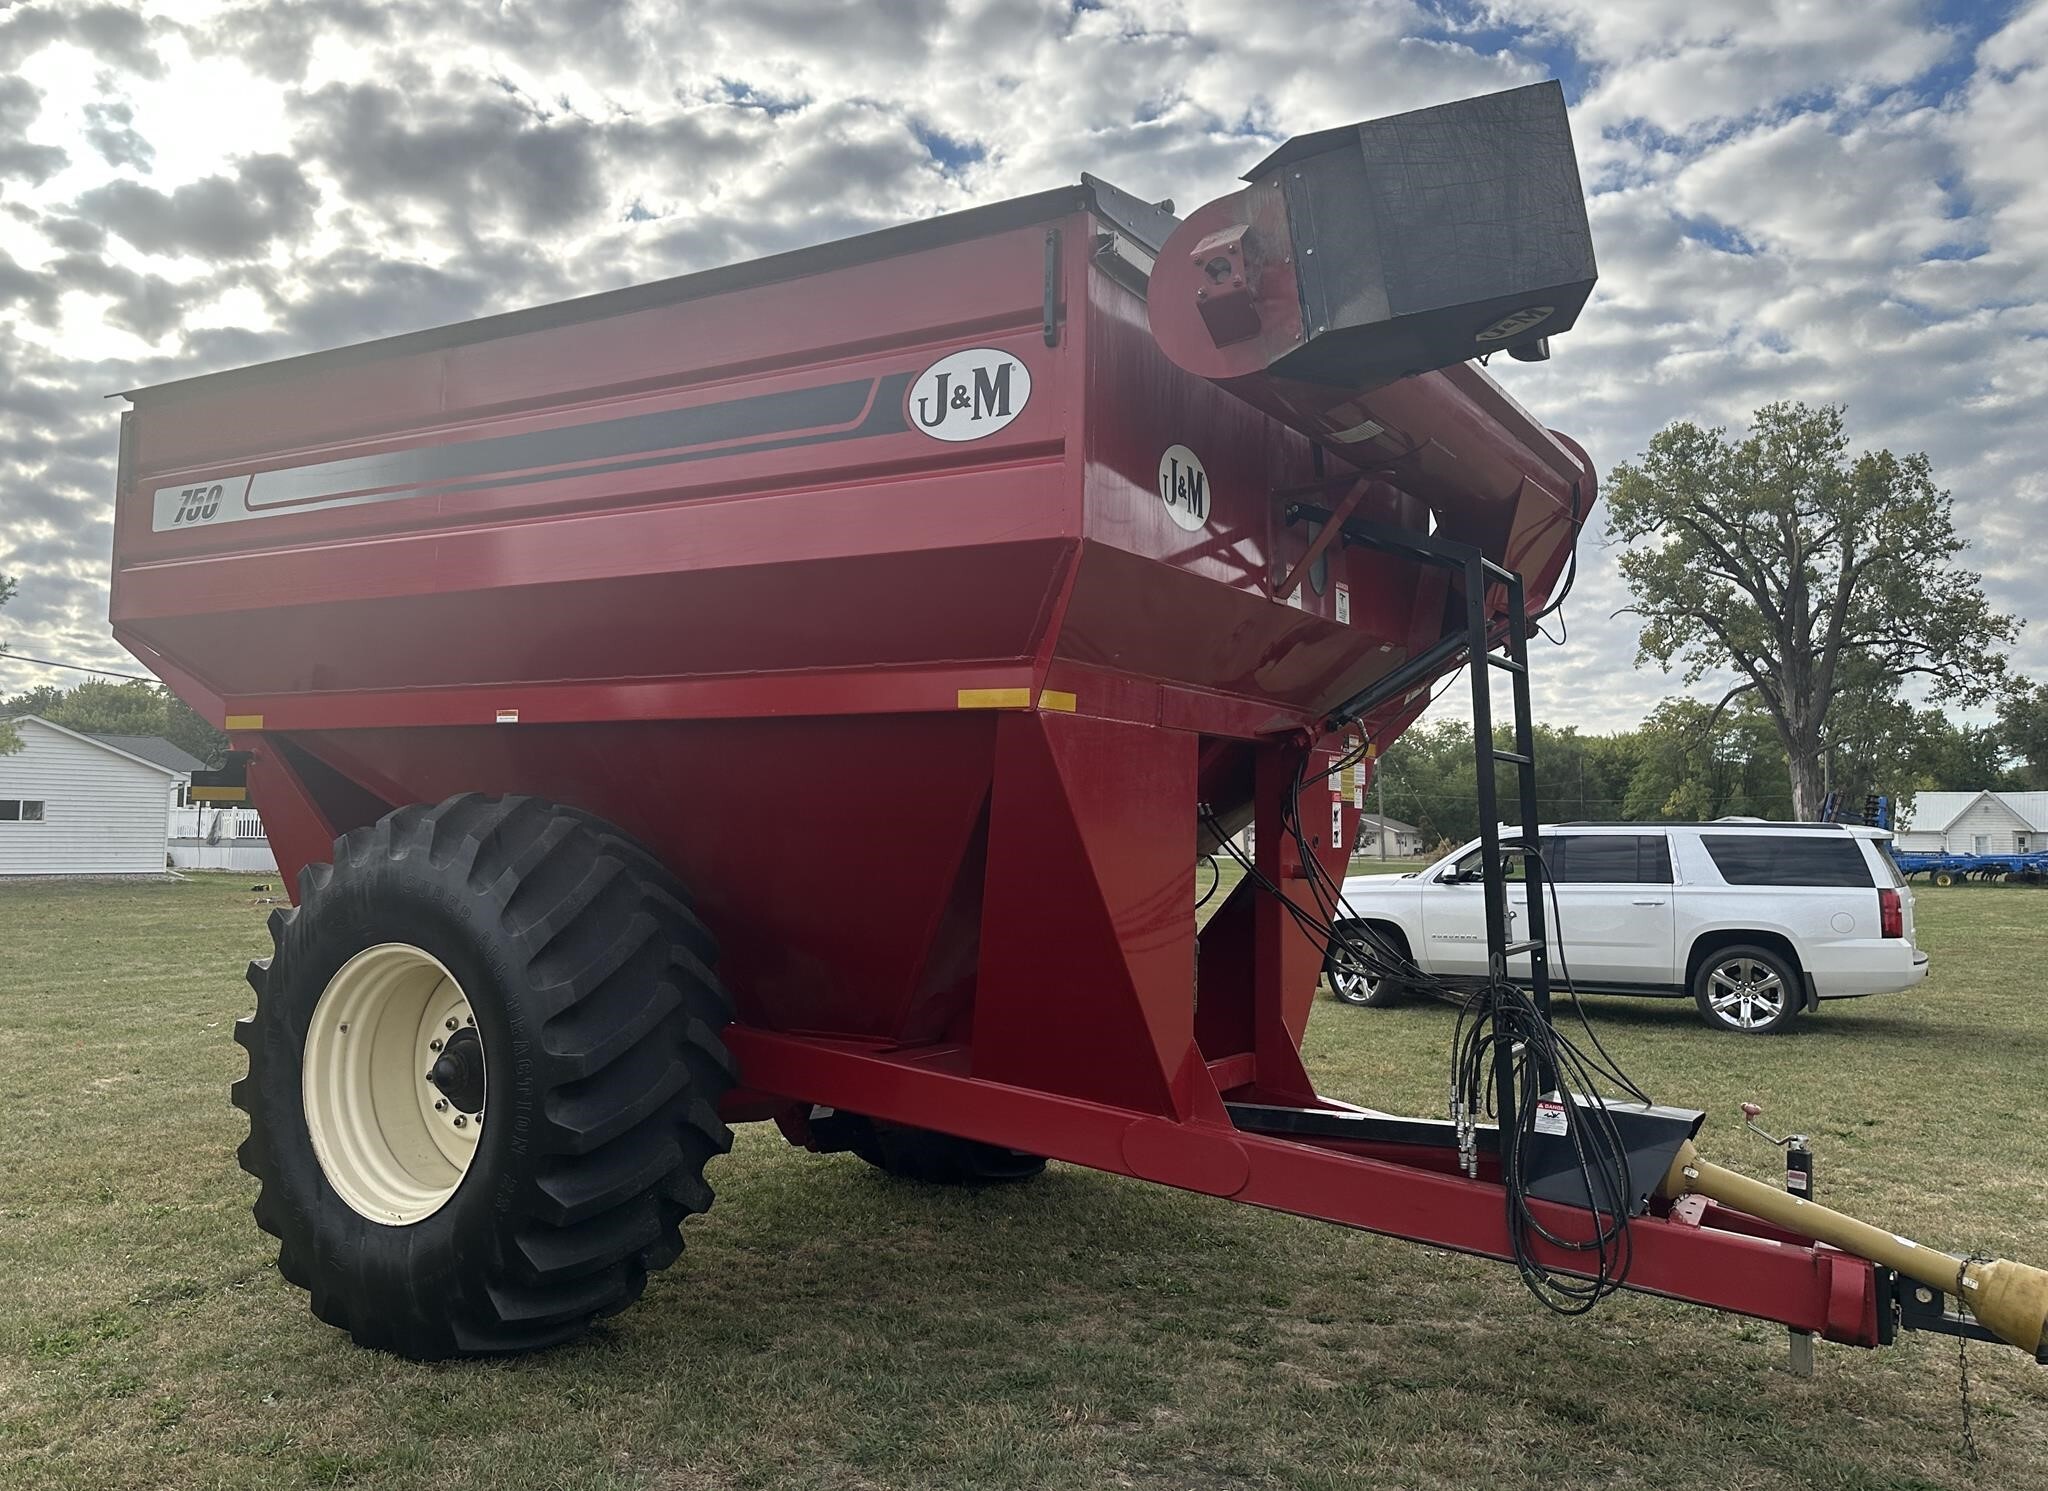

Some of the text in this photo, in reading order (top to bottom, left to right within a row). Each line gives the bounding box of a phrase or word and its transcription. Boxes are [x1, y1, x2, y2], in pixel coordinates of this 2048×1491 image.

[917, 361, 1013, 428] J&M
[173, 484, 223, 523] 750
[1162, 457, 1204, 520] J&M
